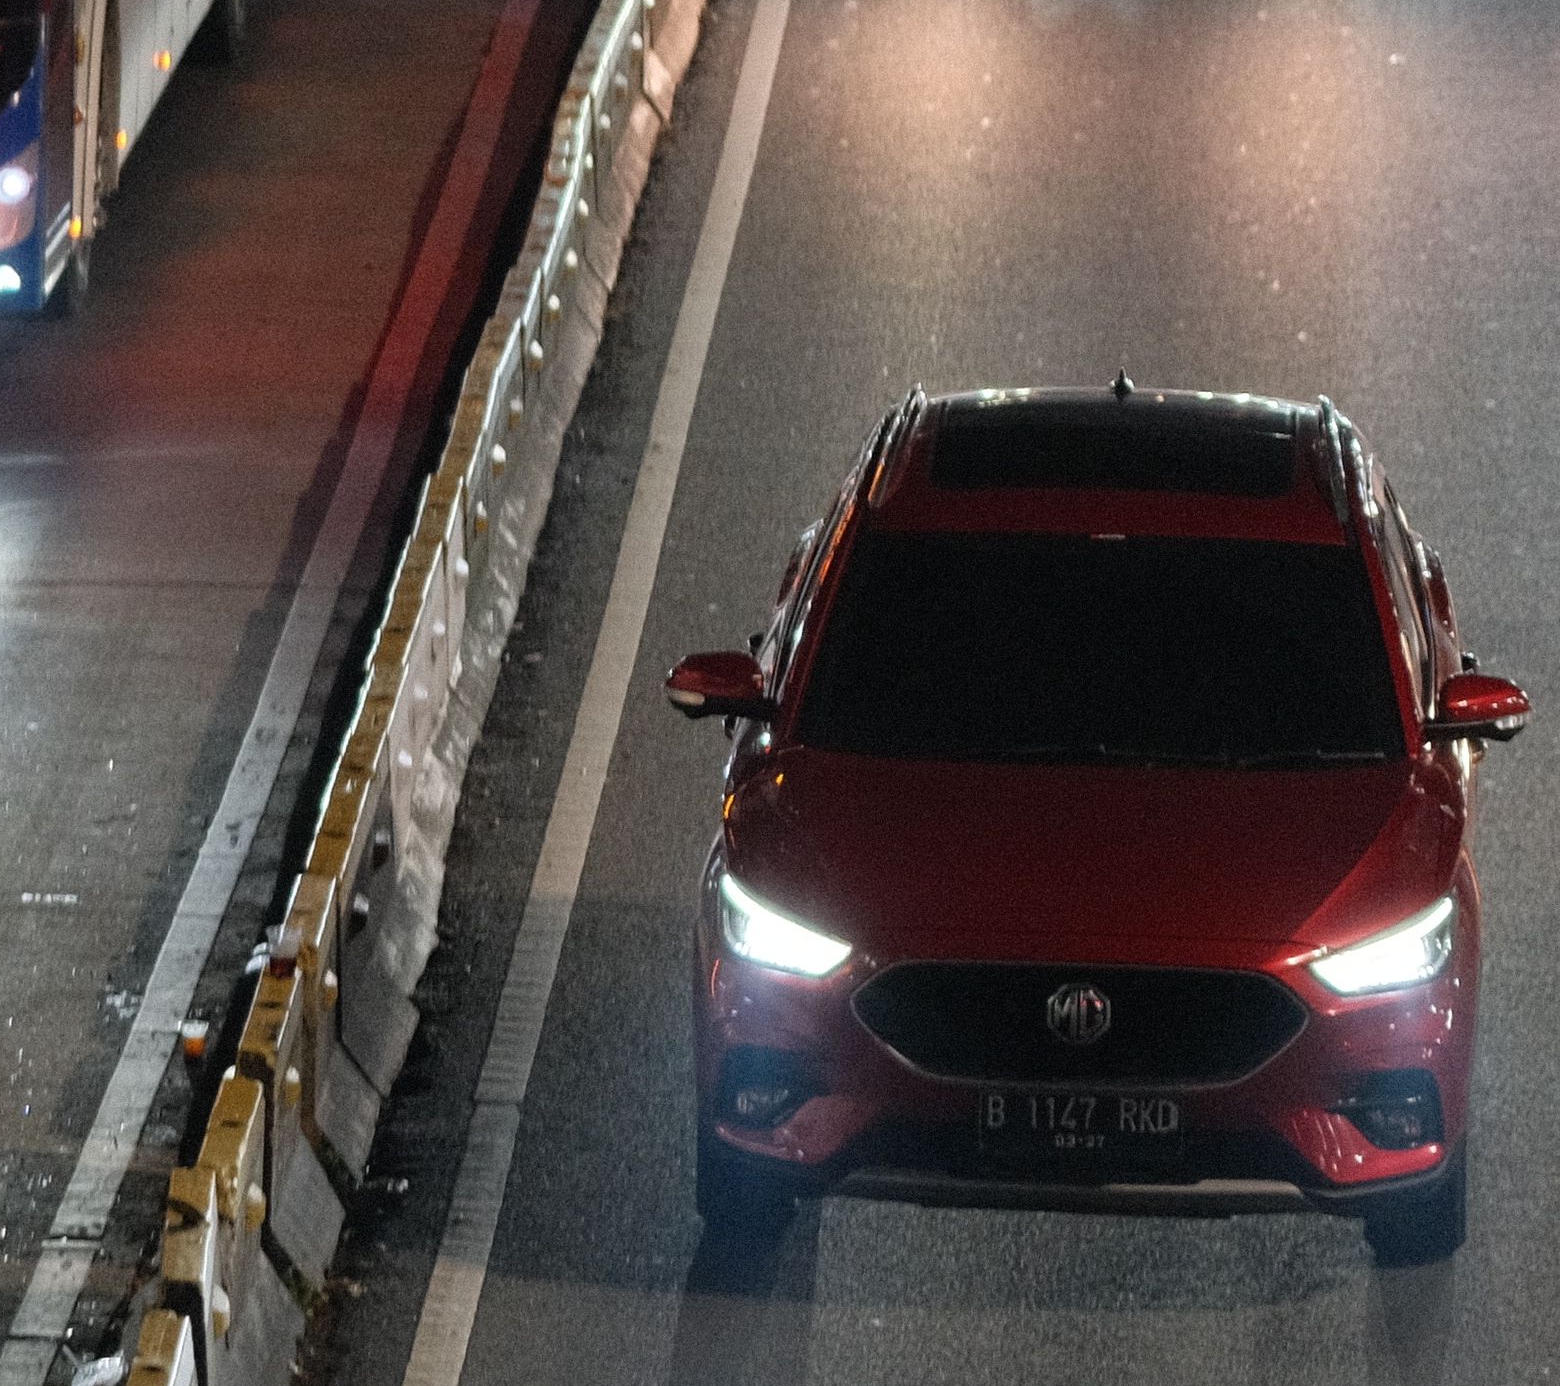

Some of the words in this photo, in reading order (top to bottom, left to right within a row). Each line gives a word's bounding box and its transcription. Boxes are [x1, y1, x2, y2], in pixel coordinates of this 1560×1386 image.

[986, 1095, 1006, 1129] B
[1028, 1096, 1097, 1131] 1147
[1119, 1097, 1181, 1134] RKD
